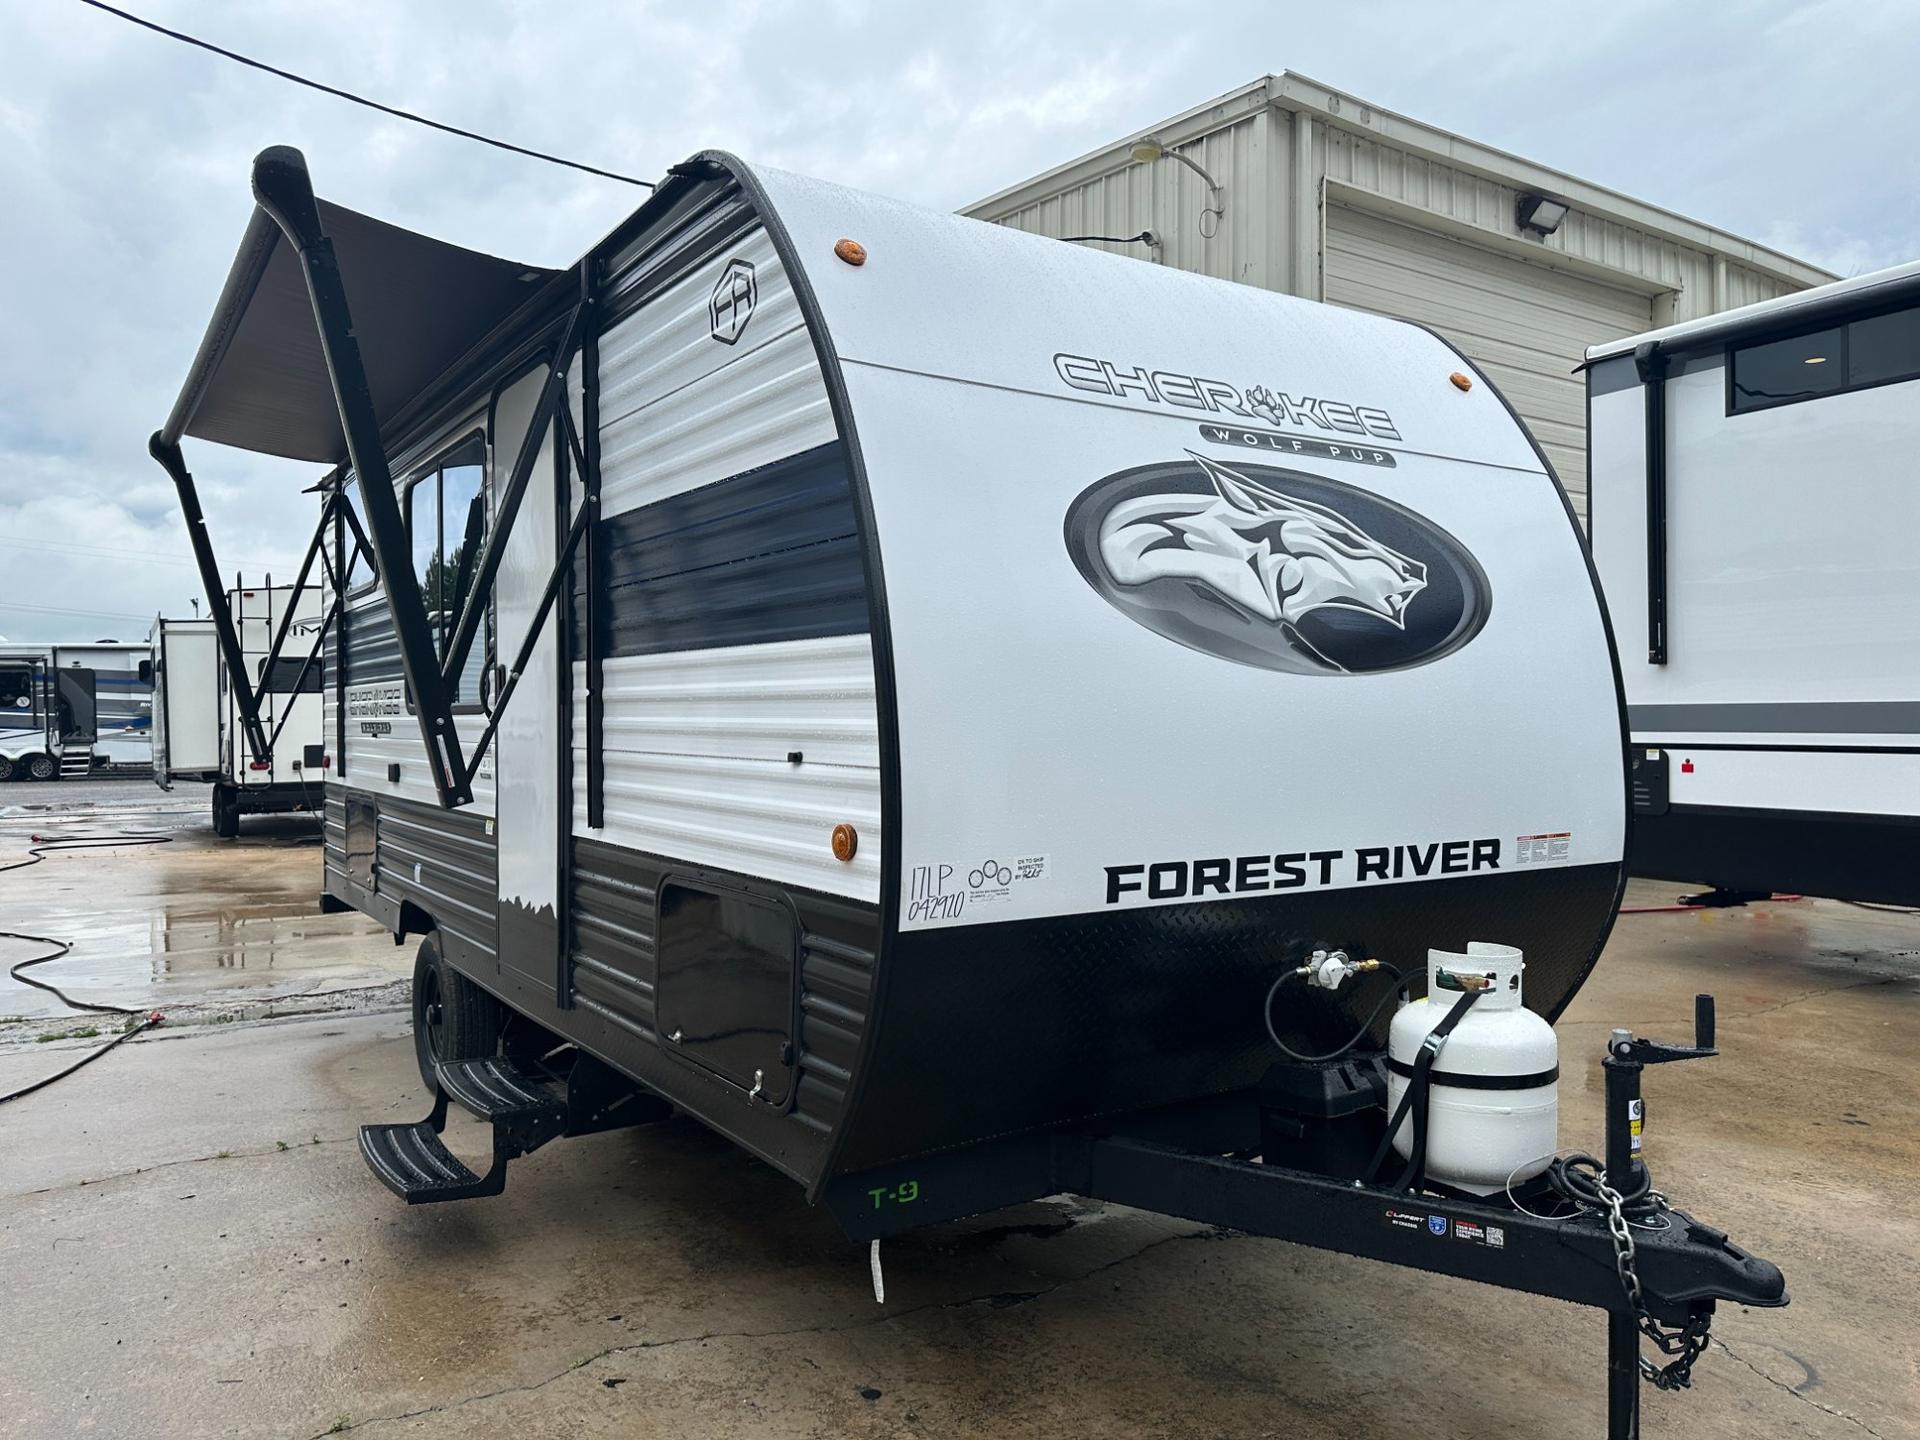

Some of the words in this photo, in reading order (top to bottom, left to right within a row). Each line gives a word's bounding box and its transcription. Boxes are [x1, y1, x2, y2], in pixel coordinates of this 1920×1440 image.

[1212, 427, 1303, 453] WOLF
[1329, 445, 1386, 464] PUP
[1103, 849, 1343, 904] FOREST
[1355, 838, 1501, 881] RIVER
[908, 890, 965, 921] 042920
[868, 1180, 919, 1209] T-9
